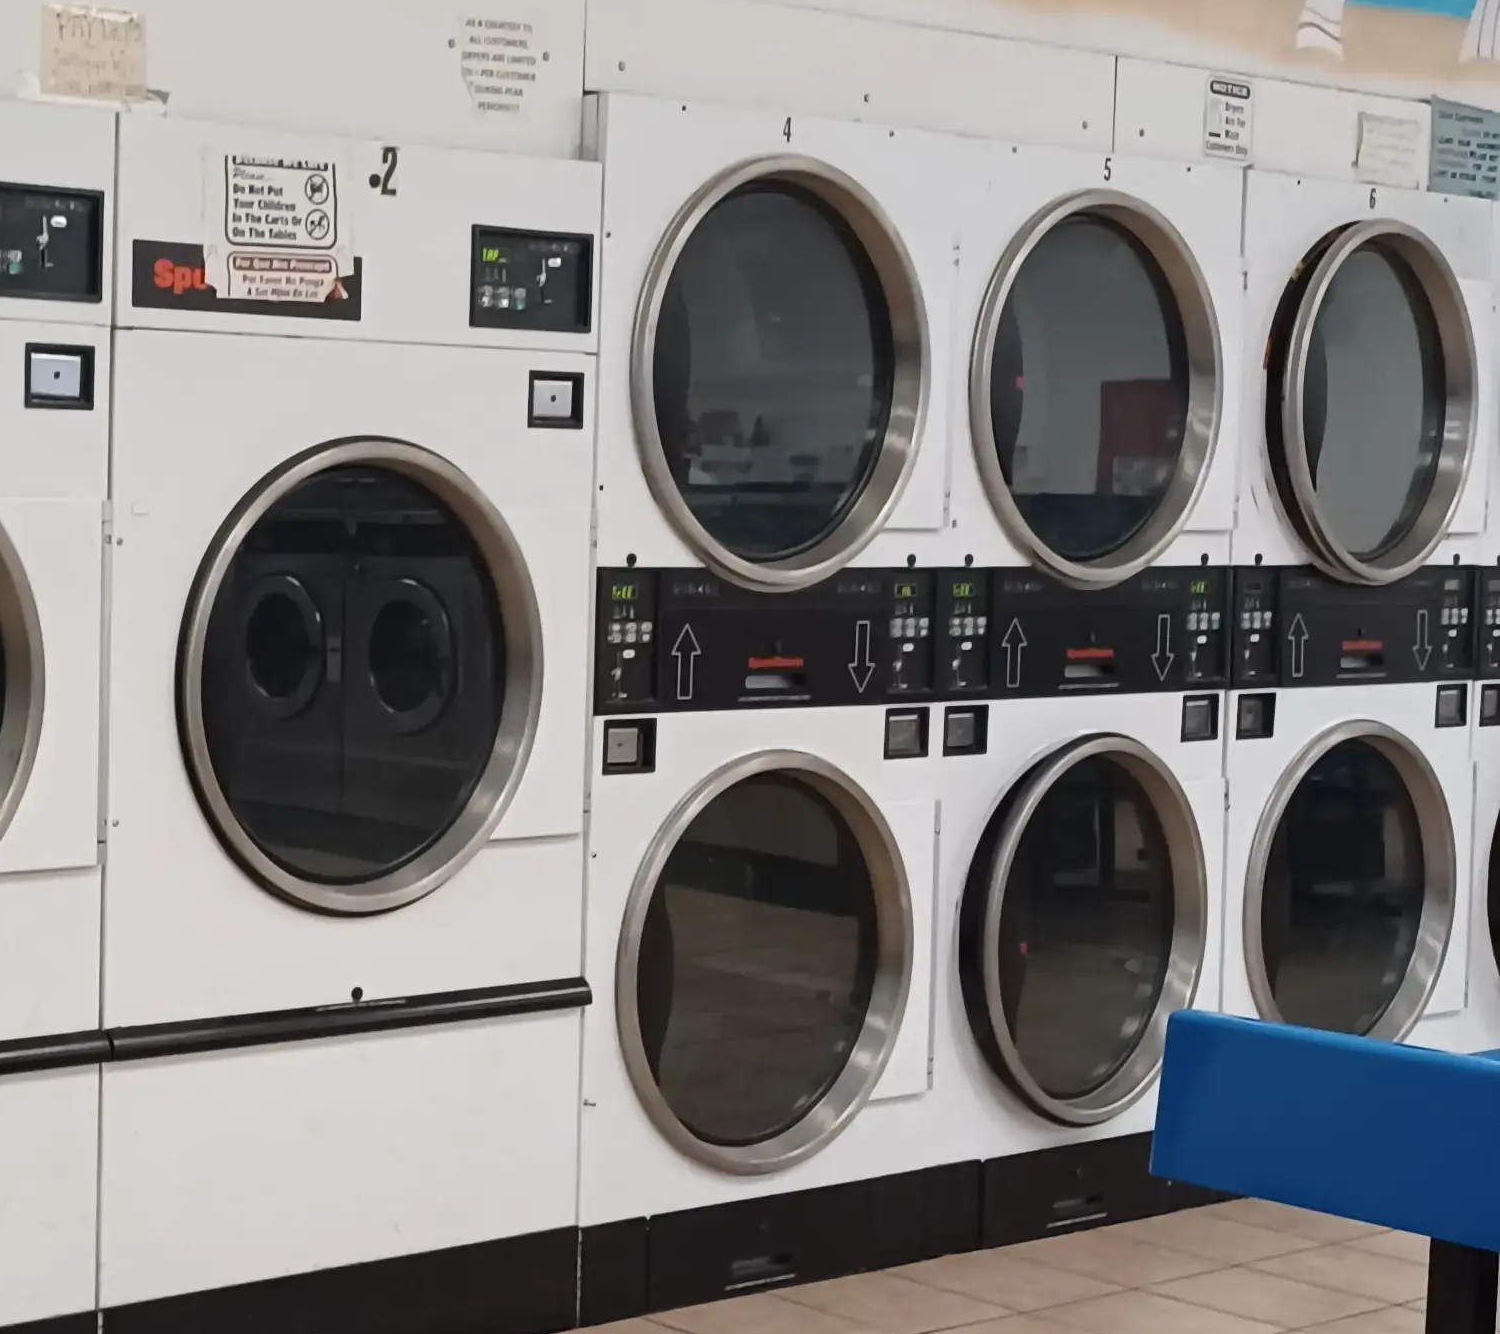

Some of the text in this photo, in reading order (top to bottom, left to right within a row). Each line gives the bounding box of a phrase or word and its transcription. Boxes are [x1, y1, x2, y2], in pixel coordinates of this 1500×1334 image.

[782, 116, 792, 144] 4
[381, 147, 398, 196] 2
[1103, 157, 1112, 182] 5
[233, 183, 283, 197] Do Not Put
[1369, 188, 1377, 209] 6
[233, 198, 296, 212] Your Children
[232, 213, 242, 223] In
[245, 213, 262, 224] The
[265, 214, 289, 226] Carts
[232, 227, 297, 240] On The Tables
